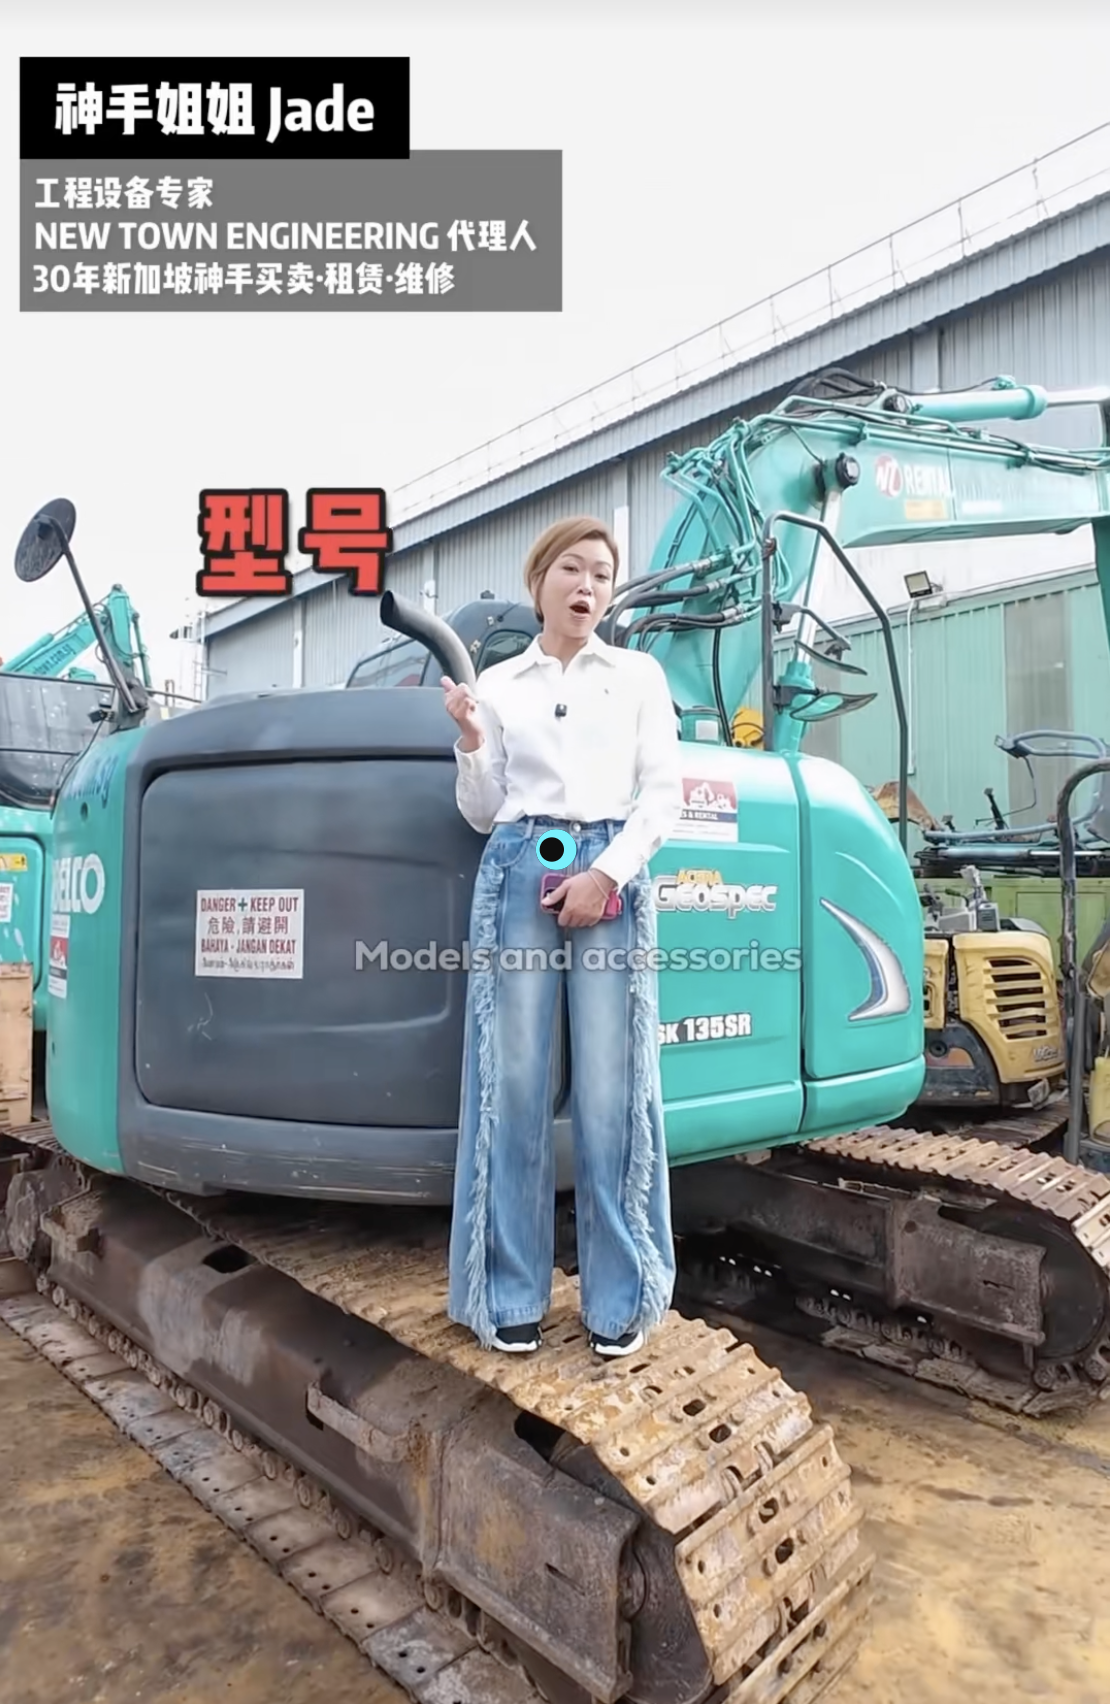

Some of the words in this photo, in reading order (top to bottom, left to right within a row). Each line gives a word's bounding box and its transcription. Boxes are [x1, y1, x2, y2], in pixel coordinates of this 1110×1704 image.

[200, 897, 236, 912] DANGER
[250, 897, 276, 912] KEEP
[278, 896, 299, 912] OUT
[201, 938, 229, 953] BAHAYA
[236, 938, 267, 954] JANGAN
[269, 938, 296, 954] DEKAT
[683, 1013, 752, 1041] 135SR
